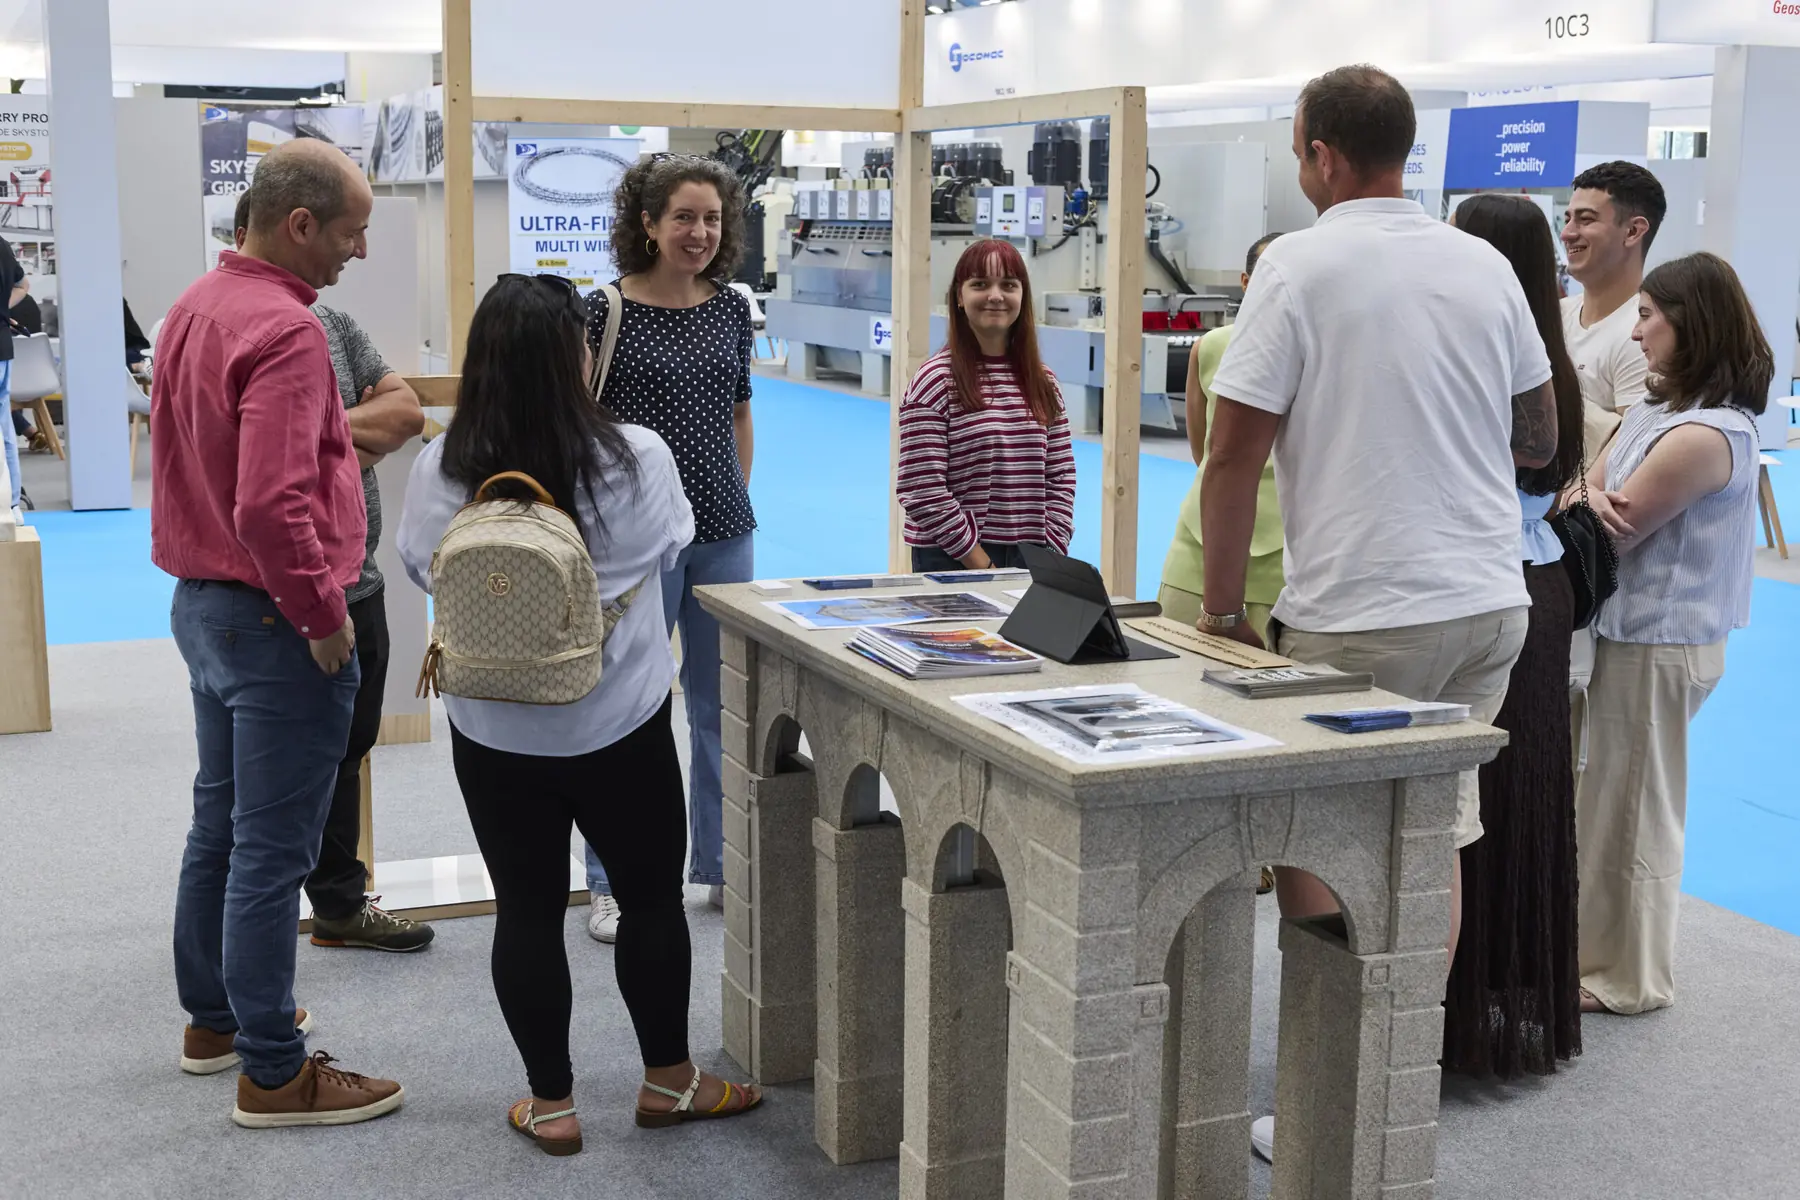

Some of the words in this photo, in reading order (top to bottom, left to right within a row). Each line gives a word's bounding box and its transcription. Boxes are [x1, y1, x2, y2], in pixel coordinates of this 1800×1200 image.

[1545, 14, 1589, 39] 10C3
[22, 113, 49, 123] PRO
[535, 241, 579, 252] MULTI
